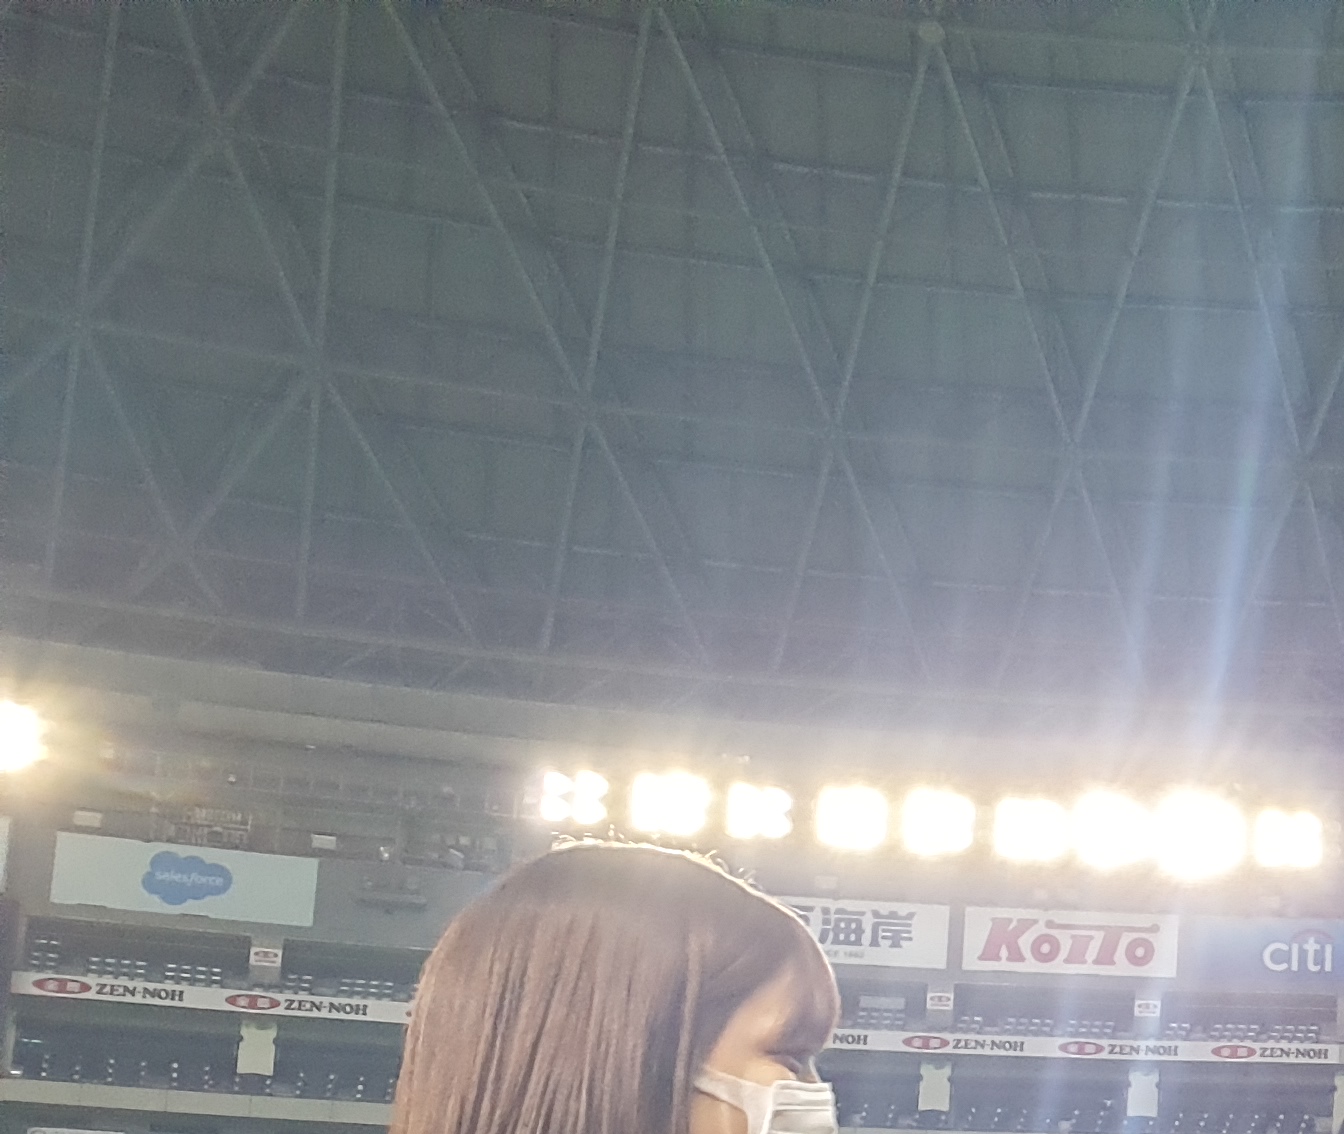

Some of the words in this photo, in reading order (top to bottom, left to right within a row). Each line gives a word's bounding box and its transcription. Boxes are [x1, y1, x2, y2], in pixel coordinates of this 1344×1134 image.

[154, 871, 225, 887] salesforce
[1262, 936, 1334, 973] citi
[95, 982, 184, 1002] ZEN-NOH
[284, 999, 368, 1016] ZEN-NOH
[952, 1037, 1025, 1053] ZEN-NOH
[1108, 1043, 1179, 1058] ZEN-NOH
[1259, 1046, 1329, 1060] ZEN-NOH
